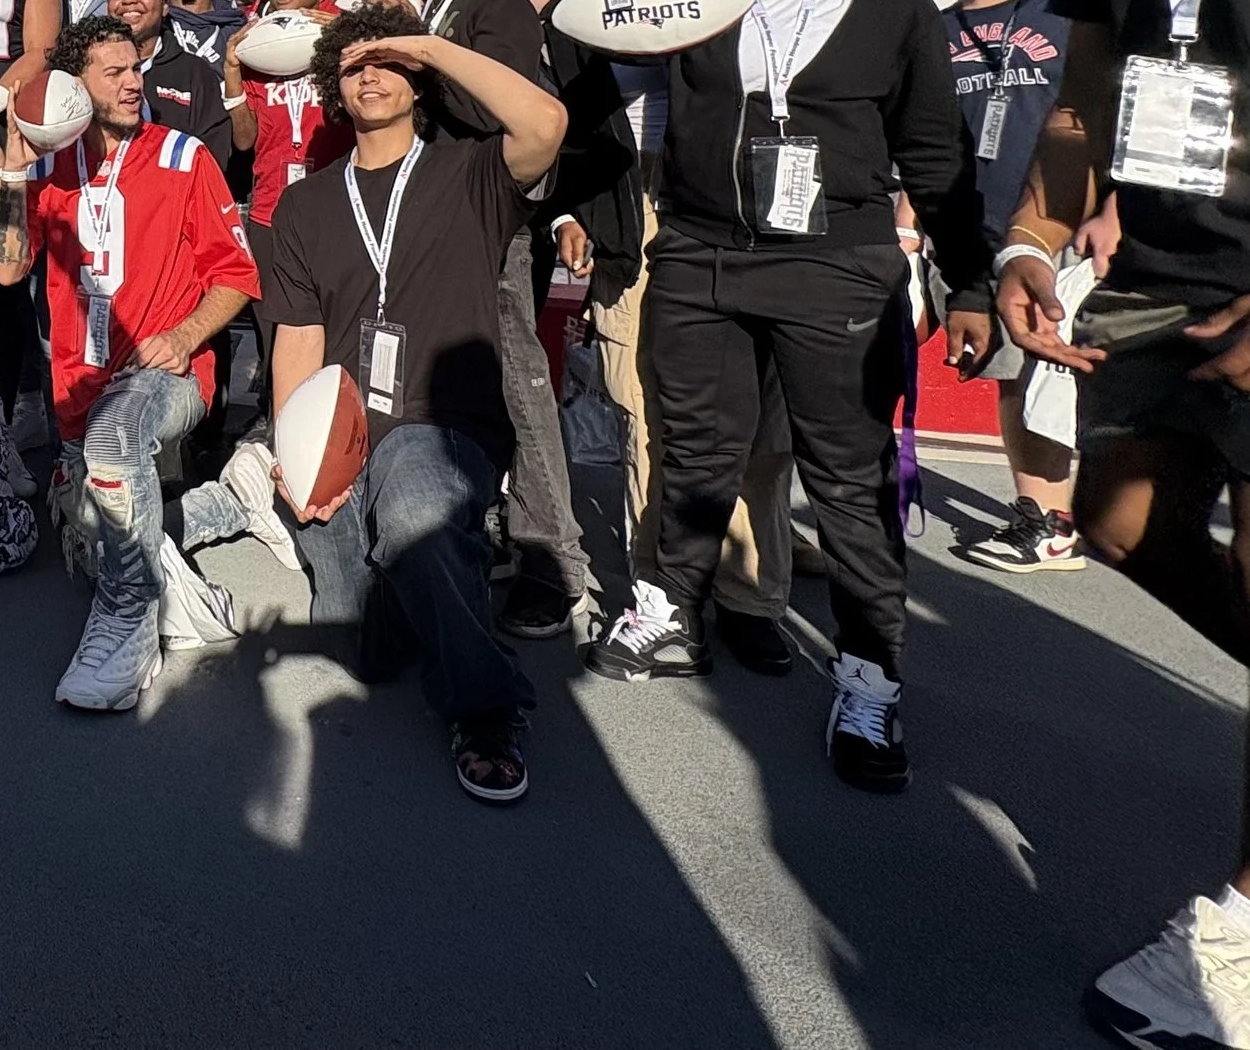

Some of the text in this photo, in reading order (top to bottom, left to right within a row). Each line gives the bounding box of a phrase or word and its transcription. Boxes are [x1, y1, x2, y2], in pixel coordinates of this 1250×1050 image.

[602, 0, 701, 30] PATRIOTS
[959, 22, 1059, 62] ENGAND
[77, 186, 125, 297] 9
